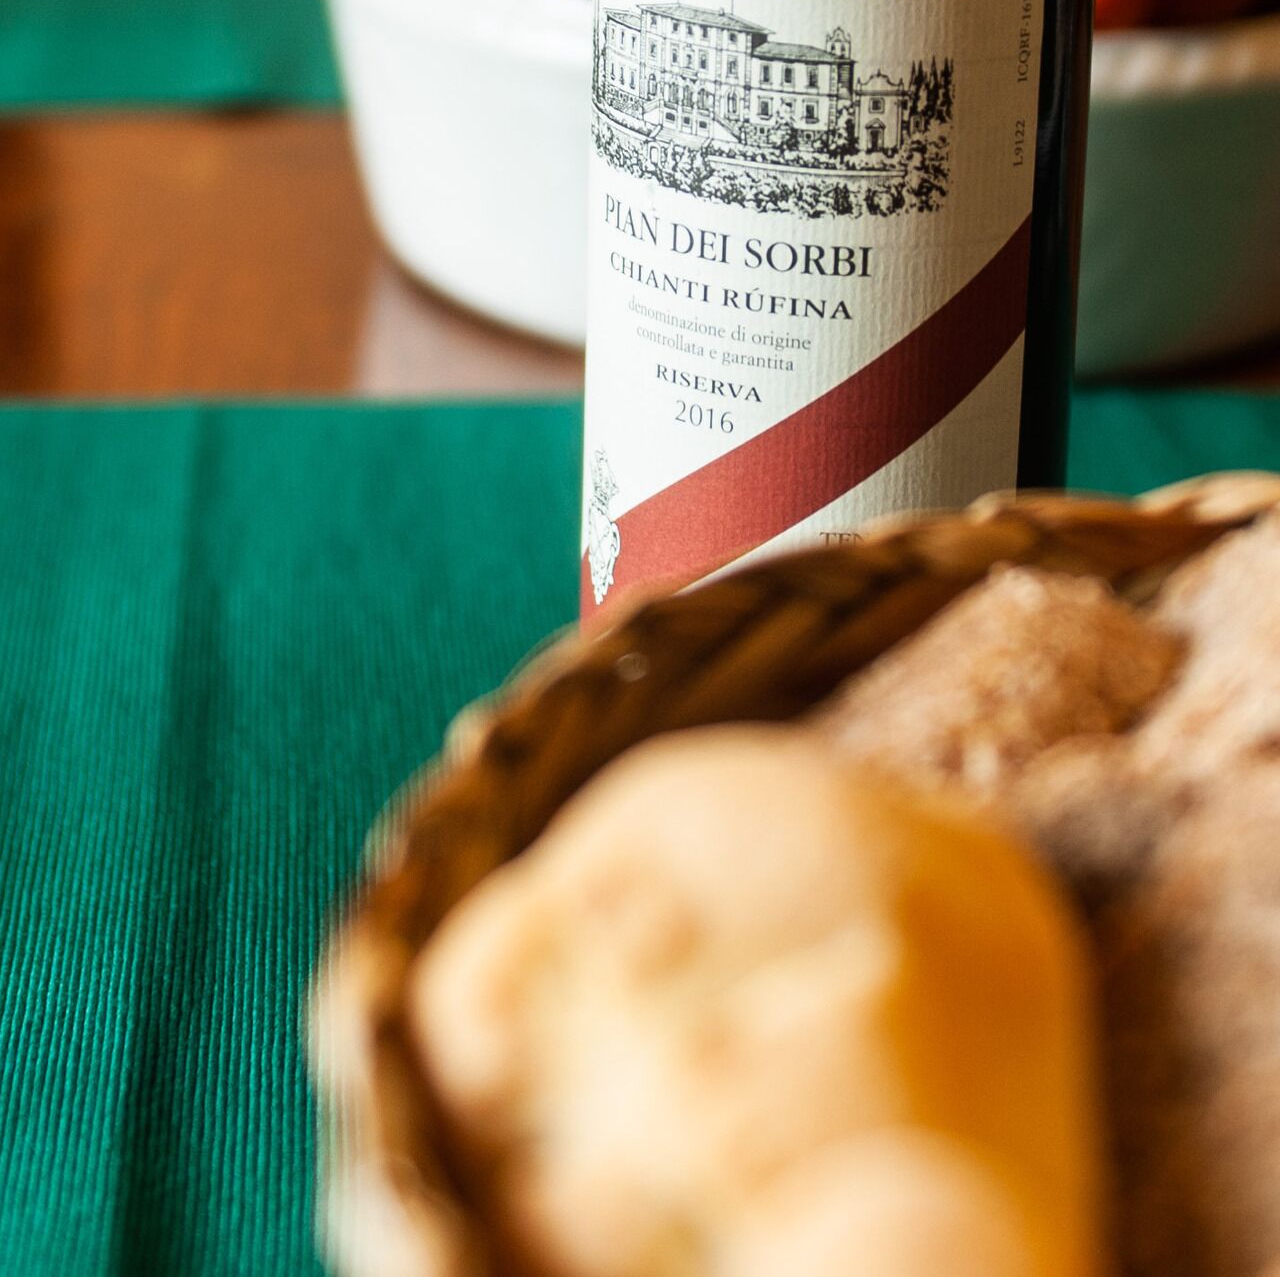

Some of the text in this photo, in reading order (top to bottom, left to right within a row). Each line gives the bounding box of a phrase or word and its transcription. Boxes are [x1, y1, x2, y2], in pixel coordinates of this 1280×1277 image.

[1012, 119, 1026, 167] L9122
[604, 193, 874, 279] PIAN DEI SORBI
[610, 251, 854, 320] CHIANTI RÚFINA
[628, 293, 812, 352] denominazione di origine
[636, 324, 795, 373] controllata e garantita
[655, 362, 763, 404] RISERVA
[674, 399, 735, 435] 2016
